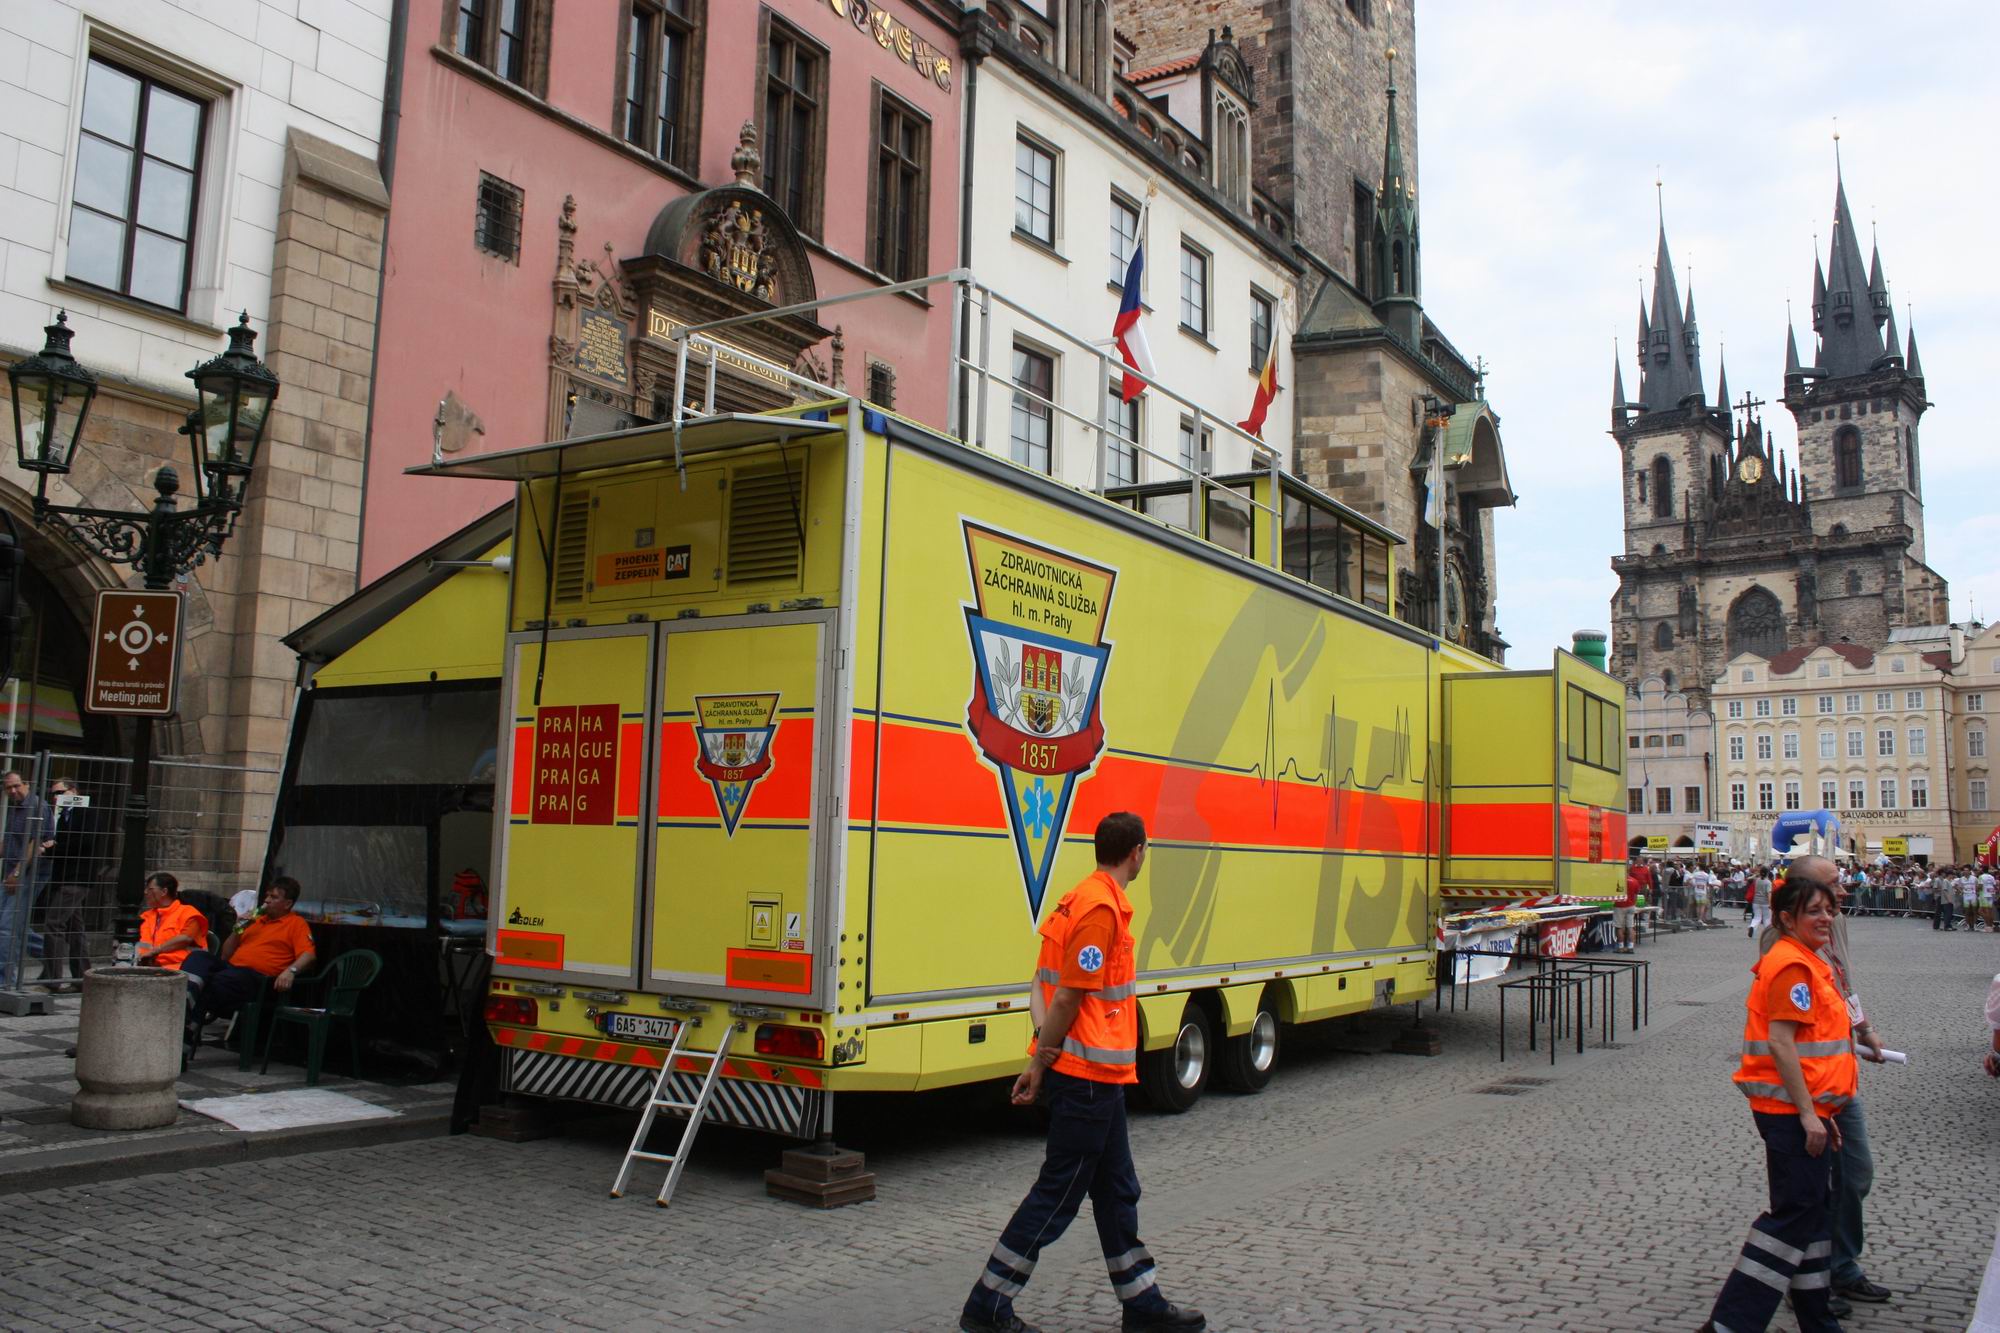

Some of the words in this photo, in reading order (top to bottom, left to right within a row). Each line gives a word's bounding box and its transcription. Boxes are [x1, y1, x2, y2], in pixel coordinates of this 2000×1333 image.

[615, 553, 659, 566] PHOENIX
[667, 553, 689, 571] CAT
[615, 567, 659, 580] ZEPPELIN
[1000, 551, 1082, 590] ZDRAVOTNICKÁ
[984, 568, 1055, 604] ZÁCHRANNÁ
[1057, 591, 1098, 616] SLUŽBA
[1012, 600, 1025, 618] hl.
[1028, 608, 1041, 622] m.
[1044, 608, 1073, 634] Prahy
[100, 690, 136, 706] Meeting
[138, 691, 161, 706] point
[713, 699, 758, 709] ZDRAVOTNICKÁ
[543, 717, 573, 733] PRA
[581, 715, 603, 733] HA
[736, 718, 752, 726] Prahy
[542, 743, 571, 759] PRA
[579, 742, 613, 758] GUE
[1020, 740, 1059, 769] 1857
[541, 768, 570, 785] PRA
[578, 768, 600, 785] GA
[722, 769, 744, 780] 1857
[539, 794, 568, 811] PRA
[577, 794, 587, 811] G
[1841, 811, 1884, 819] SALVADOR
[517, 916, 544, 927] GOLEM
[616, 1016, 636, 1033] 6A5
[643, 1020, 671, 1037] 3477
